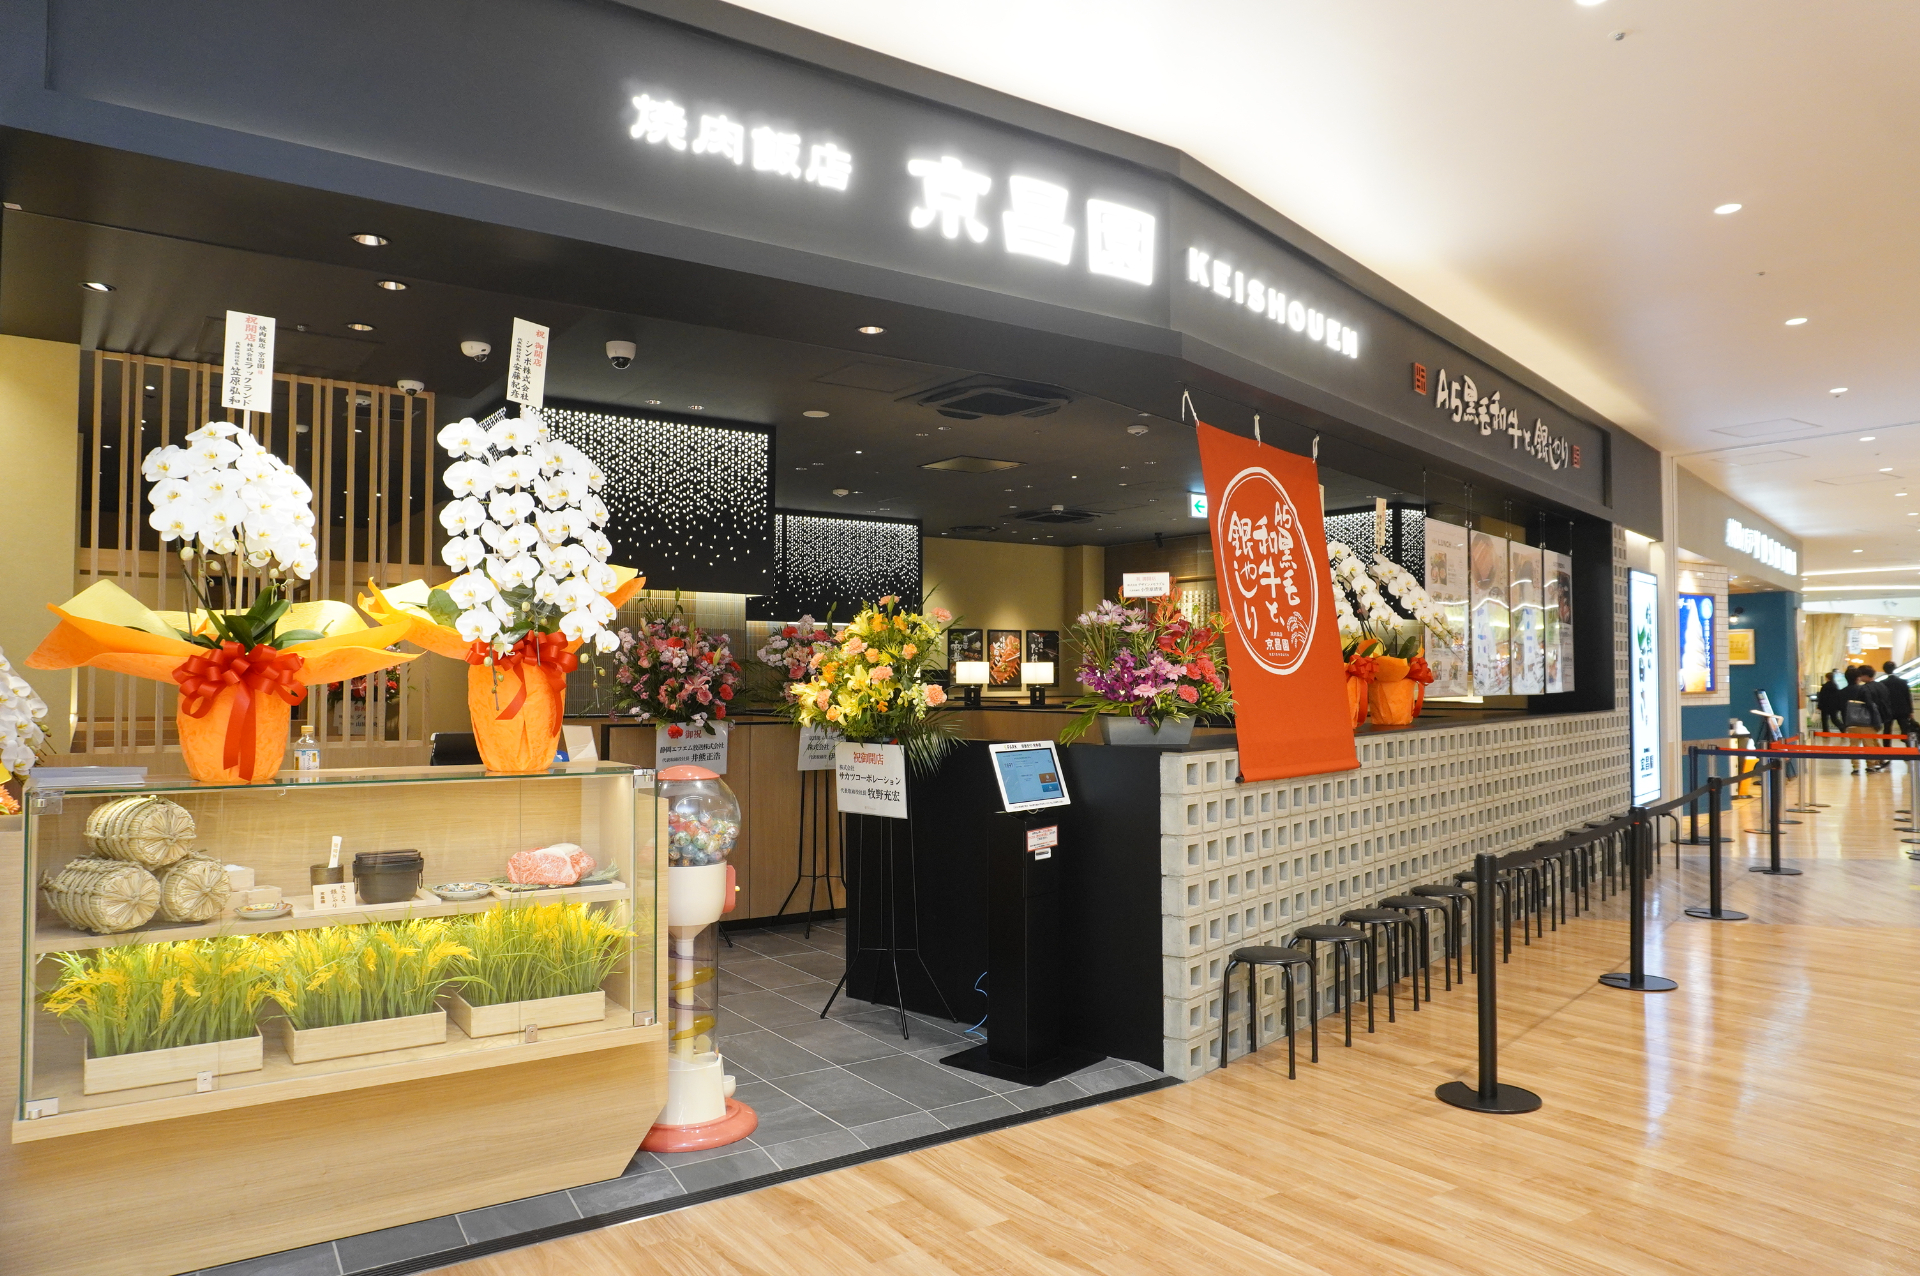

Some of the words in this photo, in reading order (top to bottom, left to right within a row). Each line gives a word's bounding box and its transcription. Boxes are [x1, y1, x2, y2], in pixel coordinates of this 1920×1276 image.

[907, 155, 1156, 286] 京昌園
[1188, 247, 1358, 359] KEISHOUEN
[244, 315, 258, 342] 祝開店
[533, 342, 544, 367] 御開店
[1228, 510, 1258, 639] 銀しゃり
[1265, 638, 1290, 651] 京昌園
[685, 730, 702, 739] 御祝
[854, 752, 884, 765] 祝御開店
[839, 772, 901, 785] サカツコーポレーション
